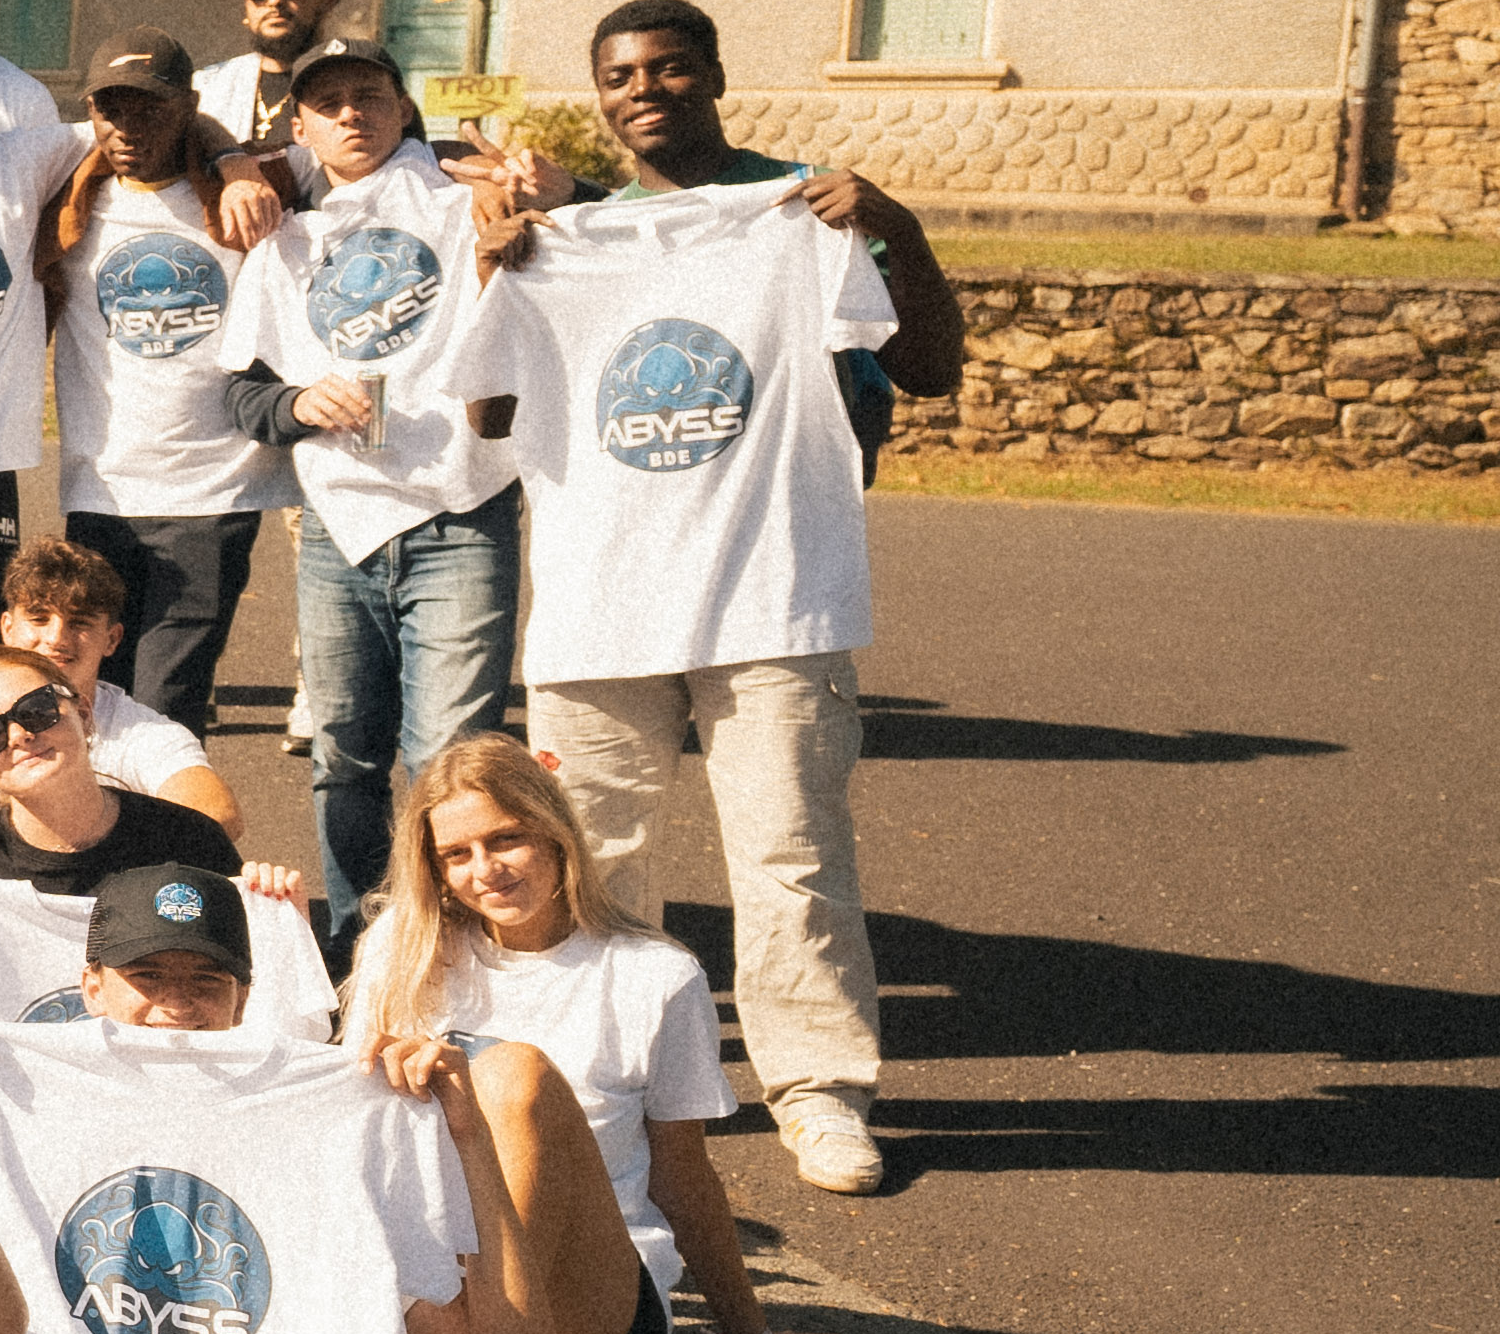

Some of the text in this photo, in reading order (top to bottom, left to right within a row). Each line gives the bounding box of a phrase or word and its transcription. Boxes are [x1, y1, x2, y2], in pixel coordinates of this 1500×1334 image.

[108, 304, 220, 338] ABYSS
[332, 275, 440, 358] ABYSS
[142, 340, 175, 354] BDE
[380, 328, 415, 354] BDE
[600, 406, 743, 452] ABYSS
[650, 450, 691, 468] BDE
[157, 906, 202, 917] ABYSS
